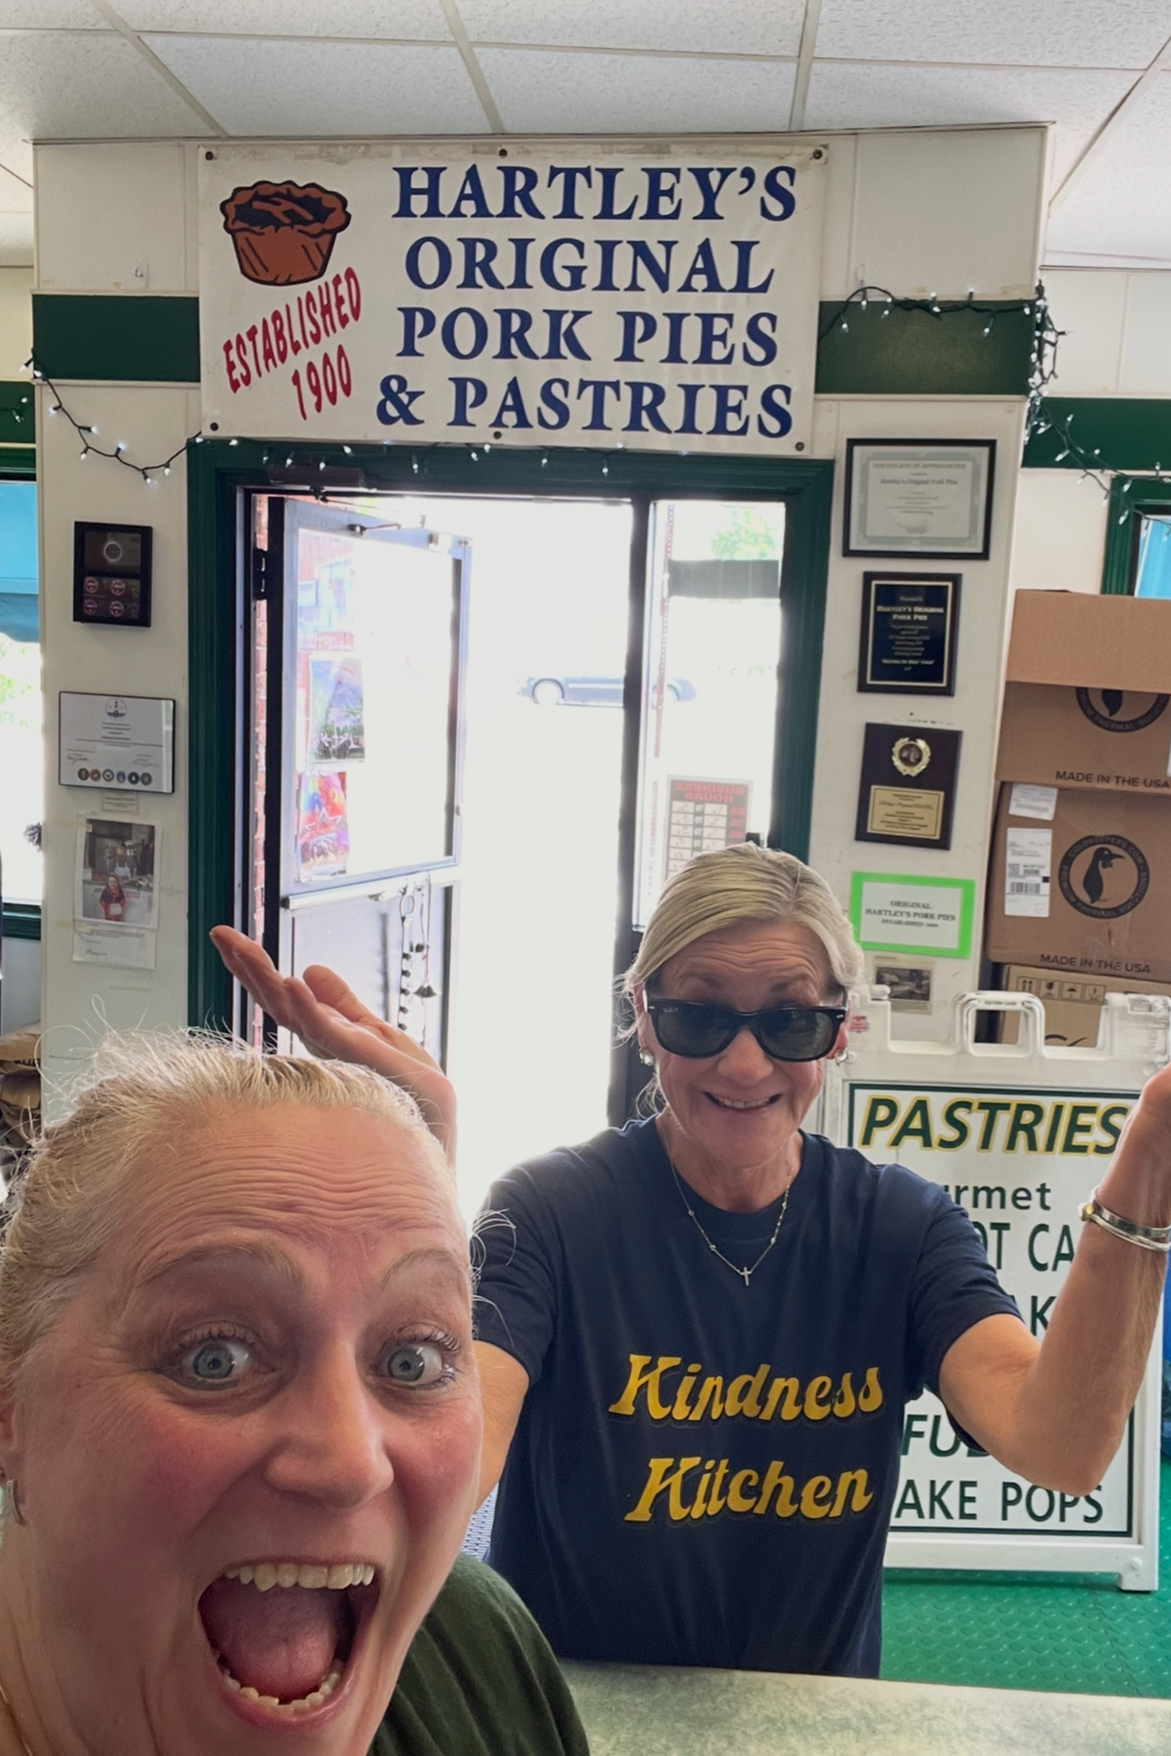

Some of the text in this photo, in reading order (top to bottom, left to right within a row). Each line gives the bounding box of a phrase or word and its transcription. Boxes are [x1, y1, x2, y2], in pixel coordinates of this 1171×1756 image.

[392, 164, 796, 221] HARTLEY'S
[405, 236, 775, 293] ORIGINAL
[222, 266, 361, 393] ESTABLISHED
[396, 307, 778, 367] PORK PIES
[291, 344, 352, 421] 1900
[376, 374, 793, 438] & PASTRIES
[1055, 770, 1171, 789] MADE IN THE USA
[865, 908, 911, 918] HARTLEY'S
[912, 912, 936, 920] PORK
[890, 900, 932, 910] ORIGINAL
[1040, 953, 1151, 973] MADE IN THE USA
[860, 1095, 1131, 1156] PASTRIES
[608, 1354, 883, 1421] Kindness
[624, 1457, 873, 1522] Kitchen
[1001, 1482, 1103, 1523] POPS
